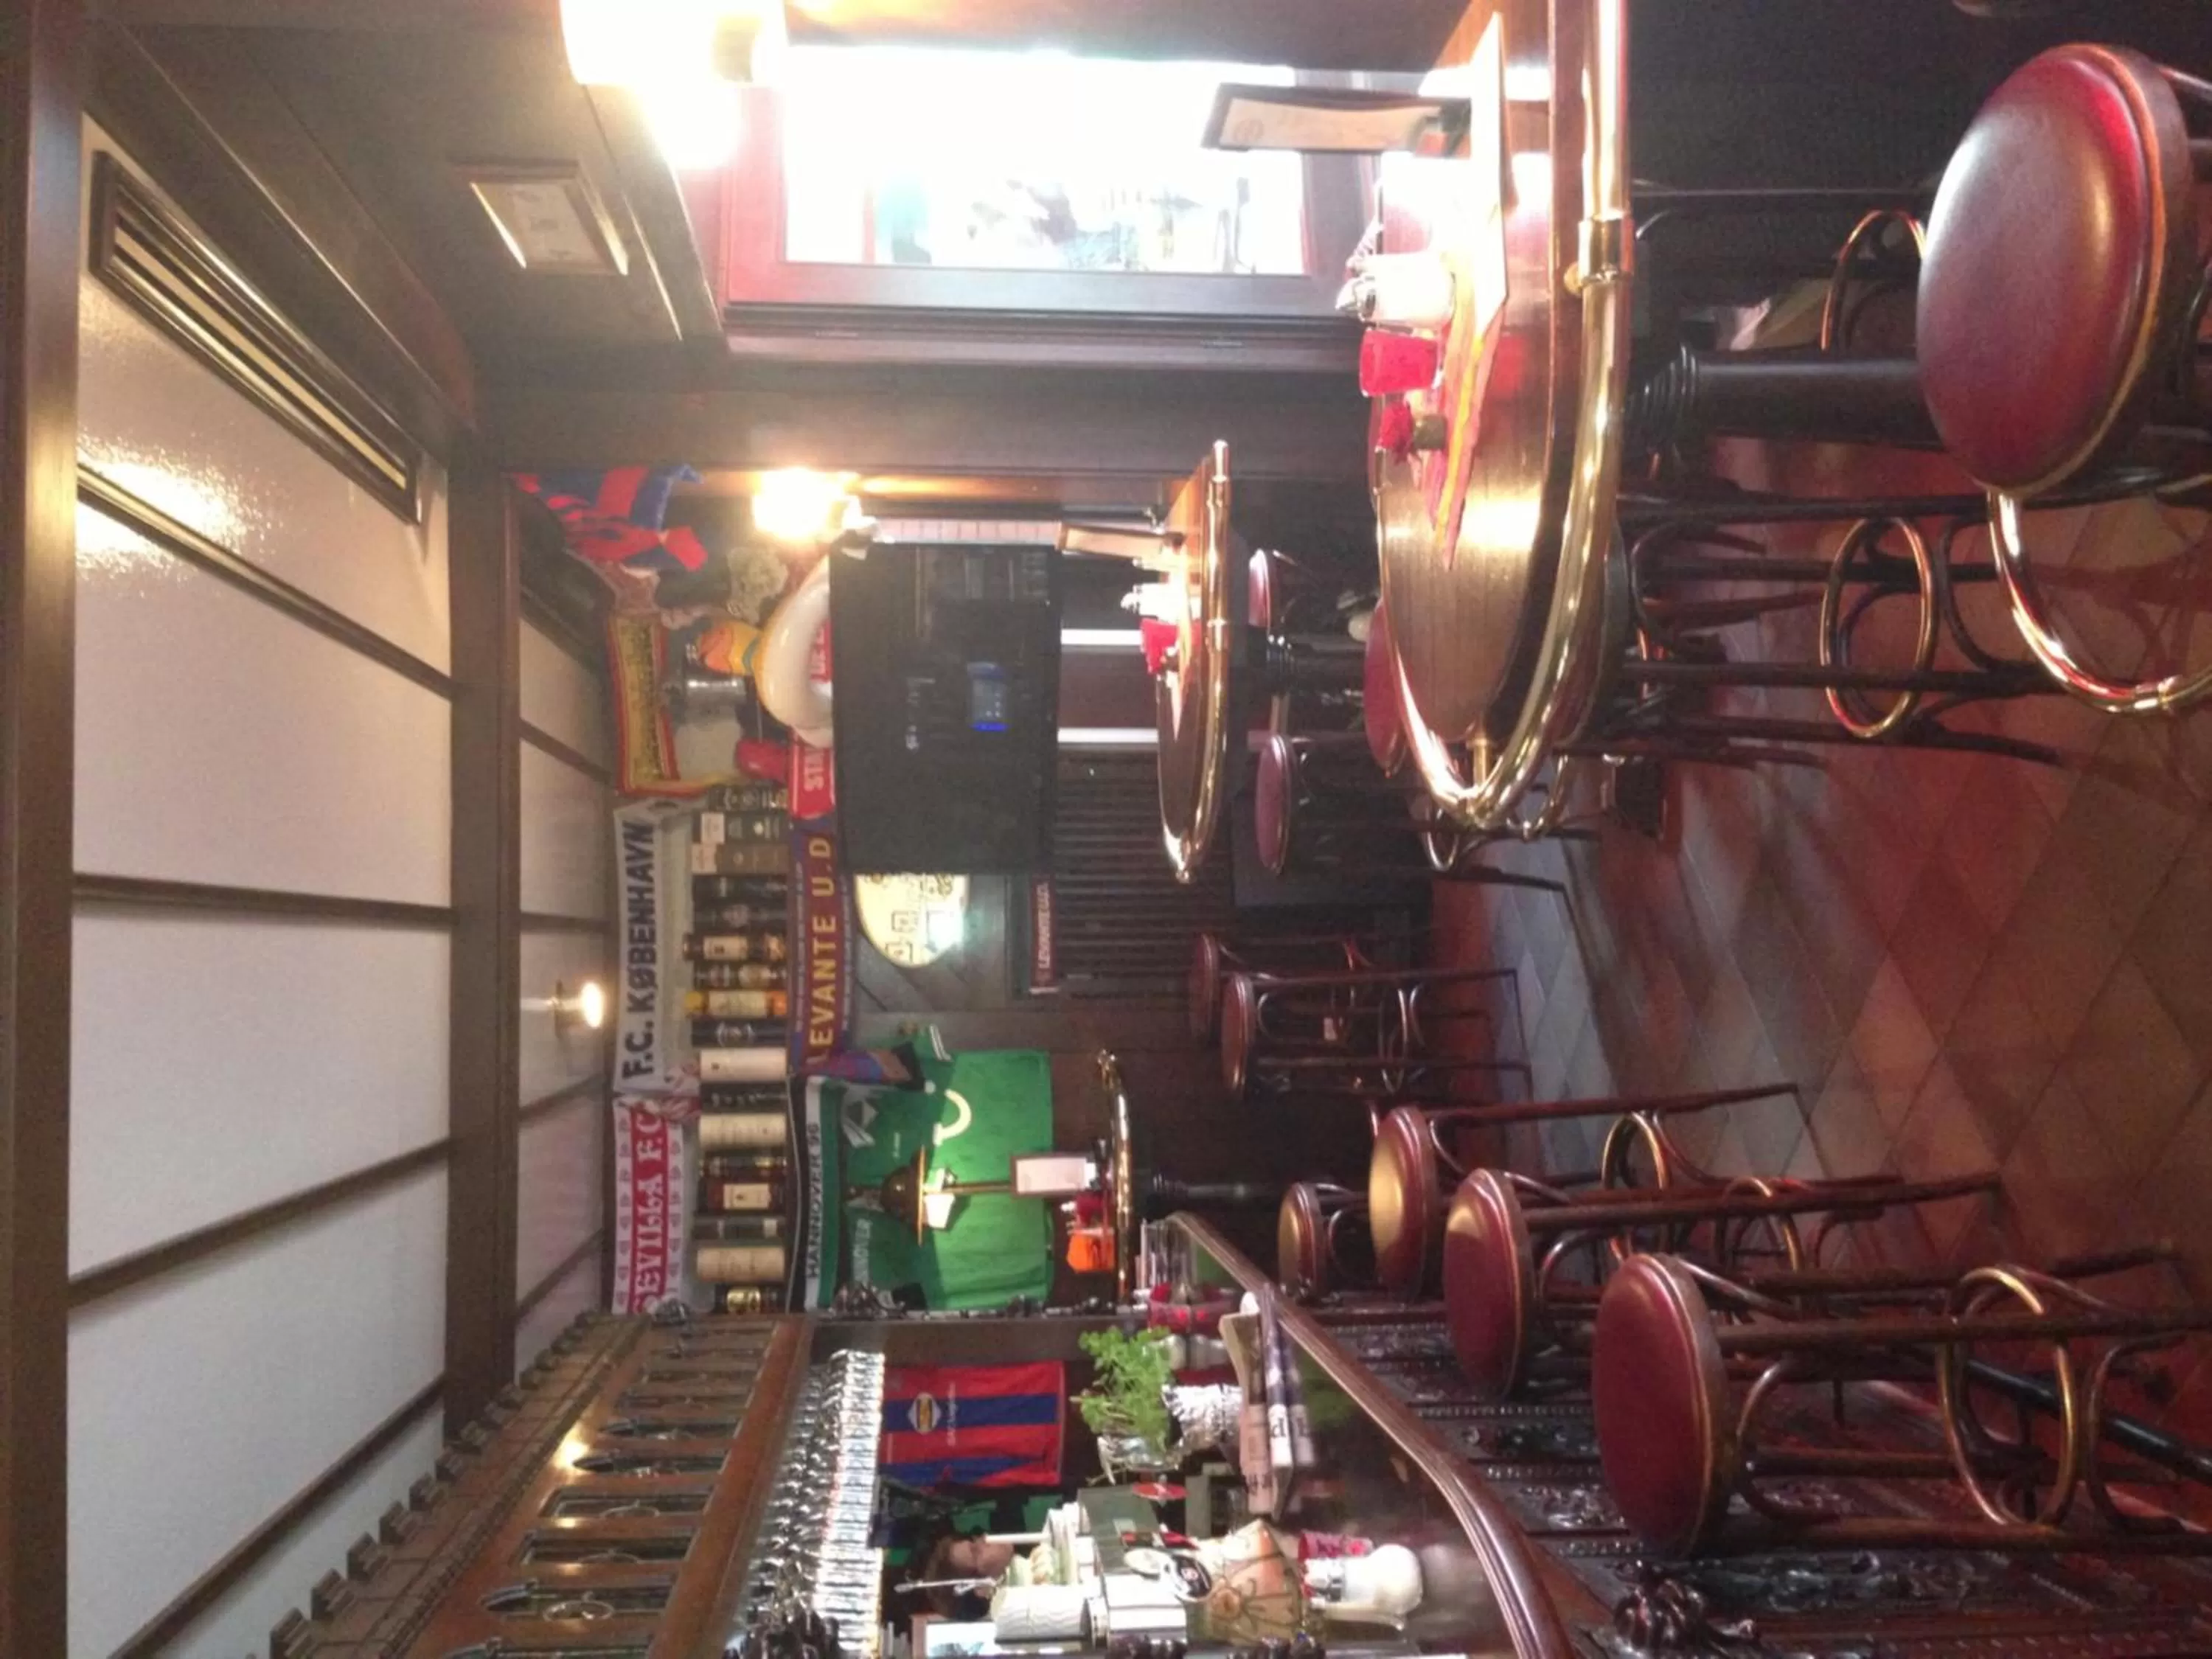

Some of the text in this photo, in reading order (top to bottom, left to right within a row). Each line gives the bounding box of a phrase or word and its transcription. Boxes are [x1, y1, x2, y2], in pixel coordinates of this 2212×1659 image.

[622, 820, 658, 1079] F.C. KØBENHAVN
[805, 914, 837, 1065] LEVANTE
[804, 1152, 823, 1279] HANNOVER
